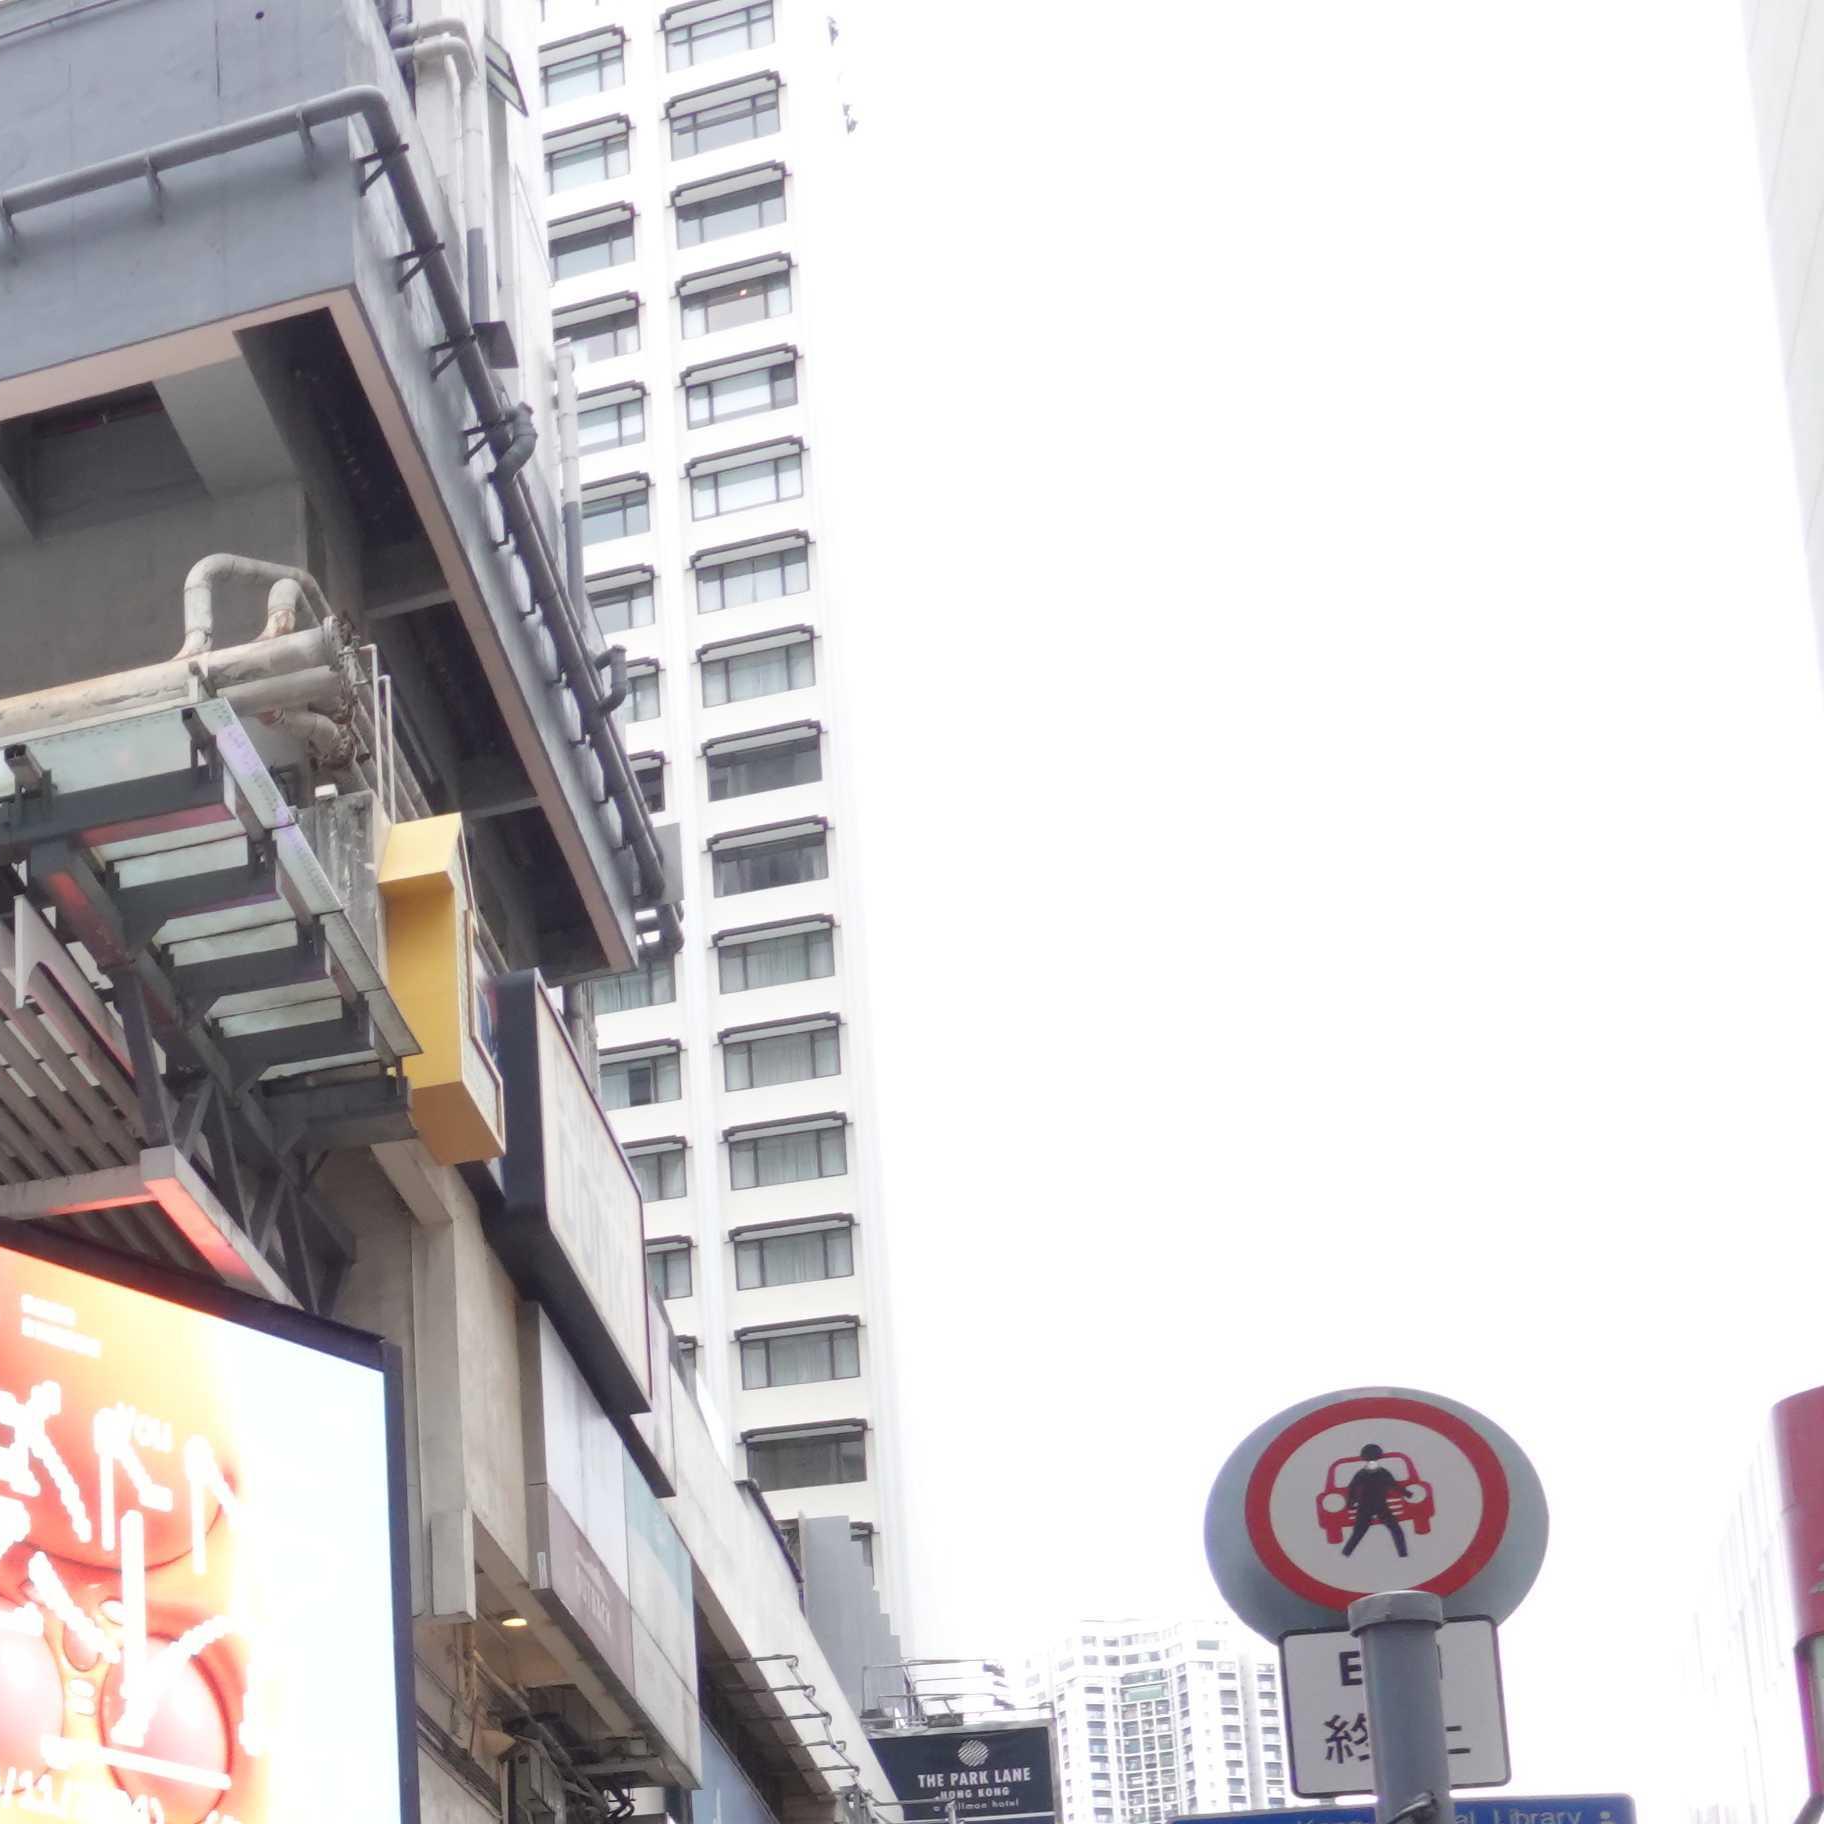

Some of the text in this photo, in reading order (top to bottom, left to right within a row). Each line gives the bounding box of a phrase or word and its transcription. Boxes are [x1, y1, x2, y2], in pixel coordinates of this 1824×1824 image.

[918, 1767, 1032, 1788] THE PARK LANE
[940, 1787, 1010, 1800] HONG KONG
